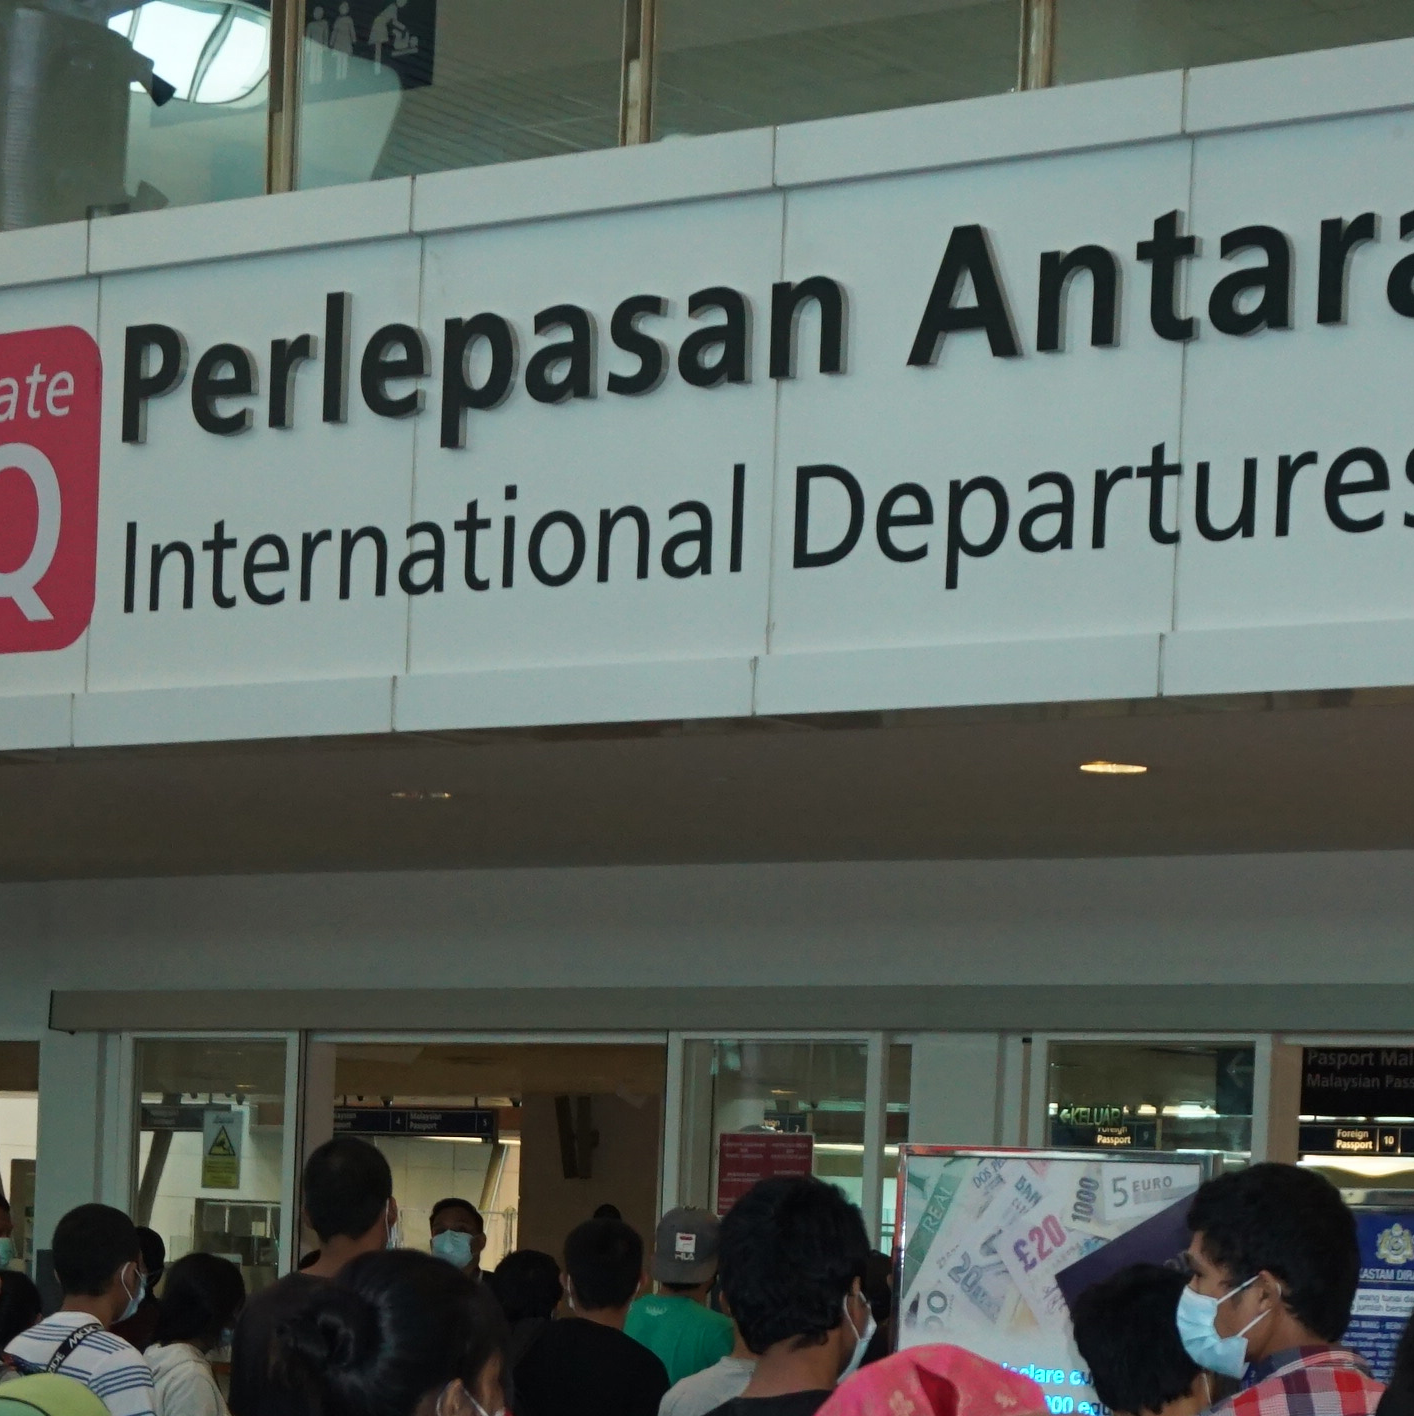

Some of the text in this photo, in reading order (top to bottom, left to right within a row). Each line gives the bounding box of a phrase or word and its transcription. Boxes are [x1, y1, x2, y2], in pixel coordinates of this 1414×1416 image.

[121, 275, 851, 450] Perlepasan
[123, 463, 746, 614] International
[1306, 1073, 1380, 1093] Malaysian
[1096, 1134, 1132, 1146] Passport
[1336, 1139, 1374, 1152] Passport
[1337, 1128, 1370, 1143] Foreign
[1384, 1134, 1396, 1146] 10
[1071, 1176, 1100, 1224] 1000
[1111, 1175, 1173, 1208] 5 EURO
[1013, 1214, 1067, 1273] £20
[1044, 1394, 1074, 1415] 00
